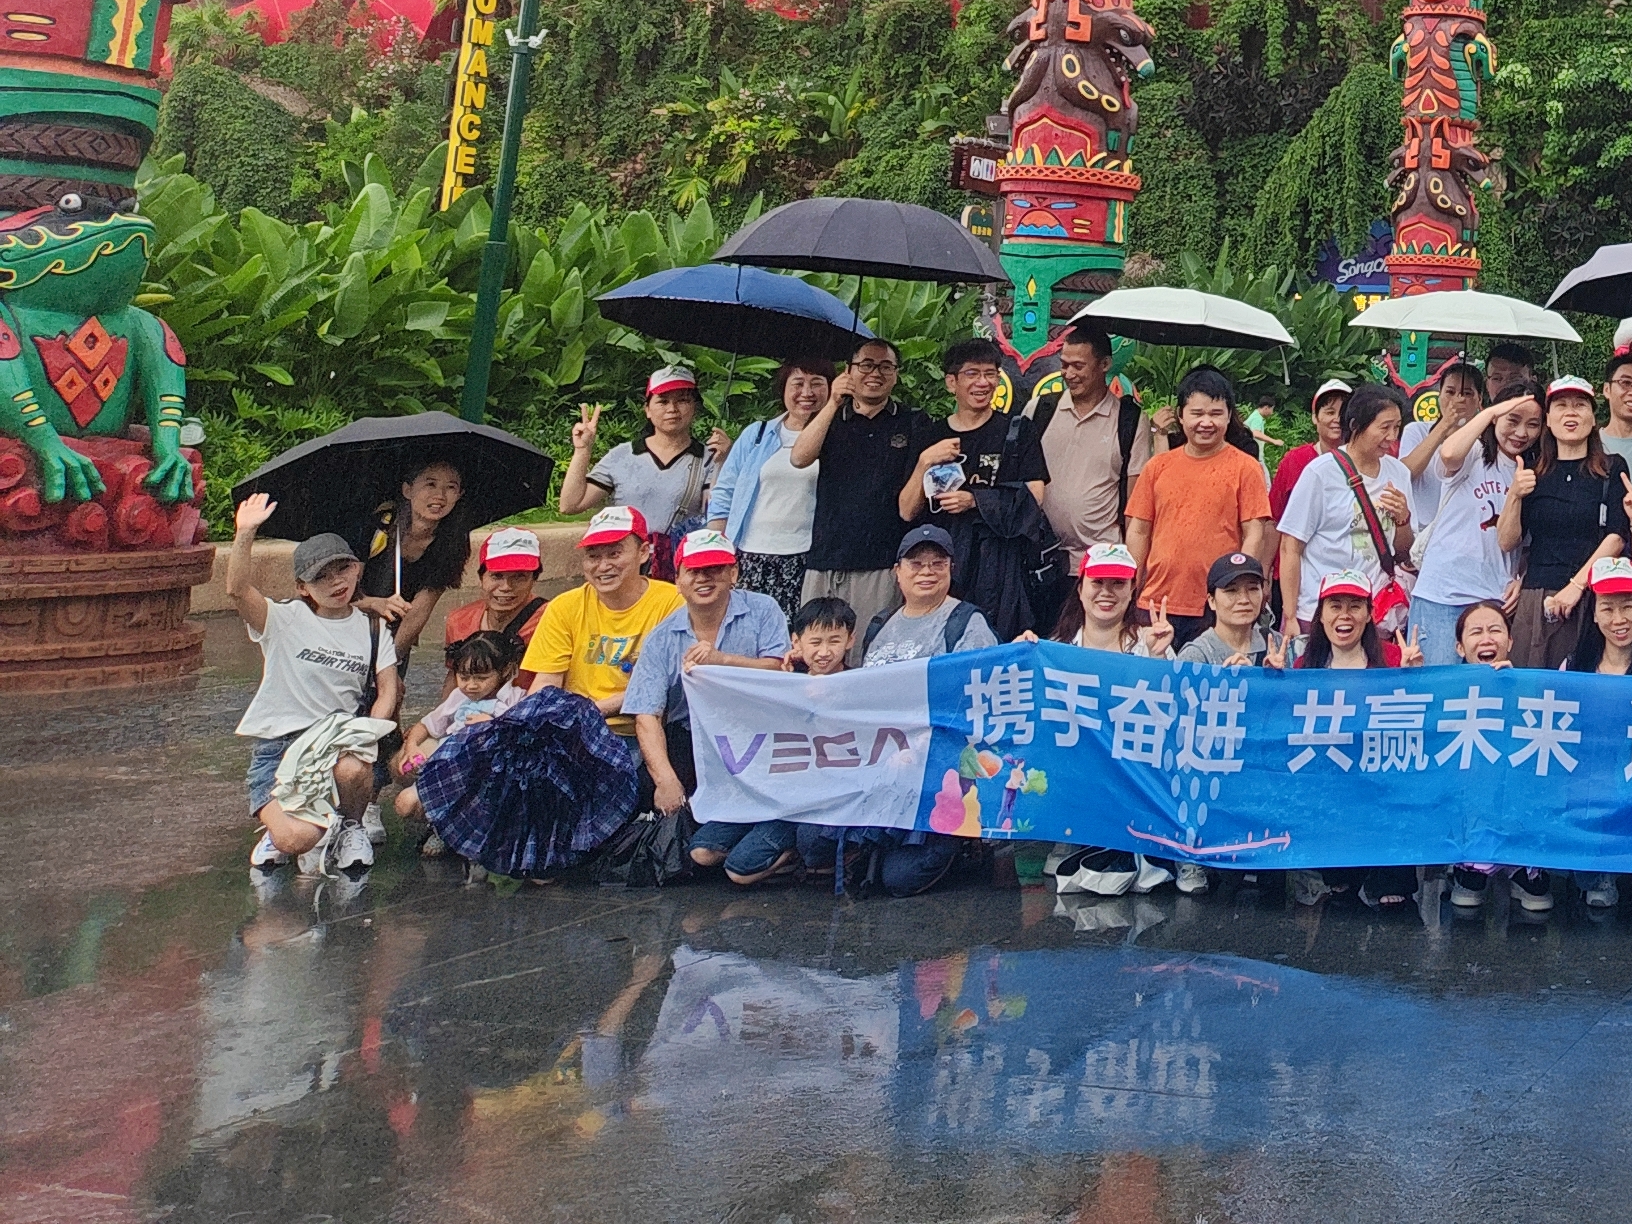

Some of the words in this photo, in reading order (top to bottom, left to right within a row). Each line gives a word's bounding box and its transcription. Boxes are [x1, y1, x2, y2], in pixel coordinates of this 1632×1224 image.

[1474, 480, 1501, 499] CUTE
[964, 667, 1247, 774] 携手奋进
[1287, 685, 1582, 776] 共赢未来
[714, 727, 911, 776] VEGA
